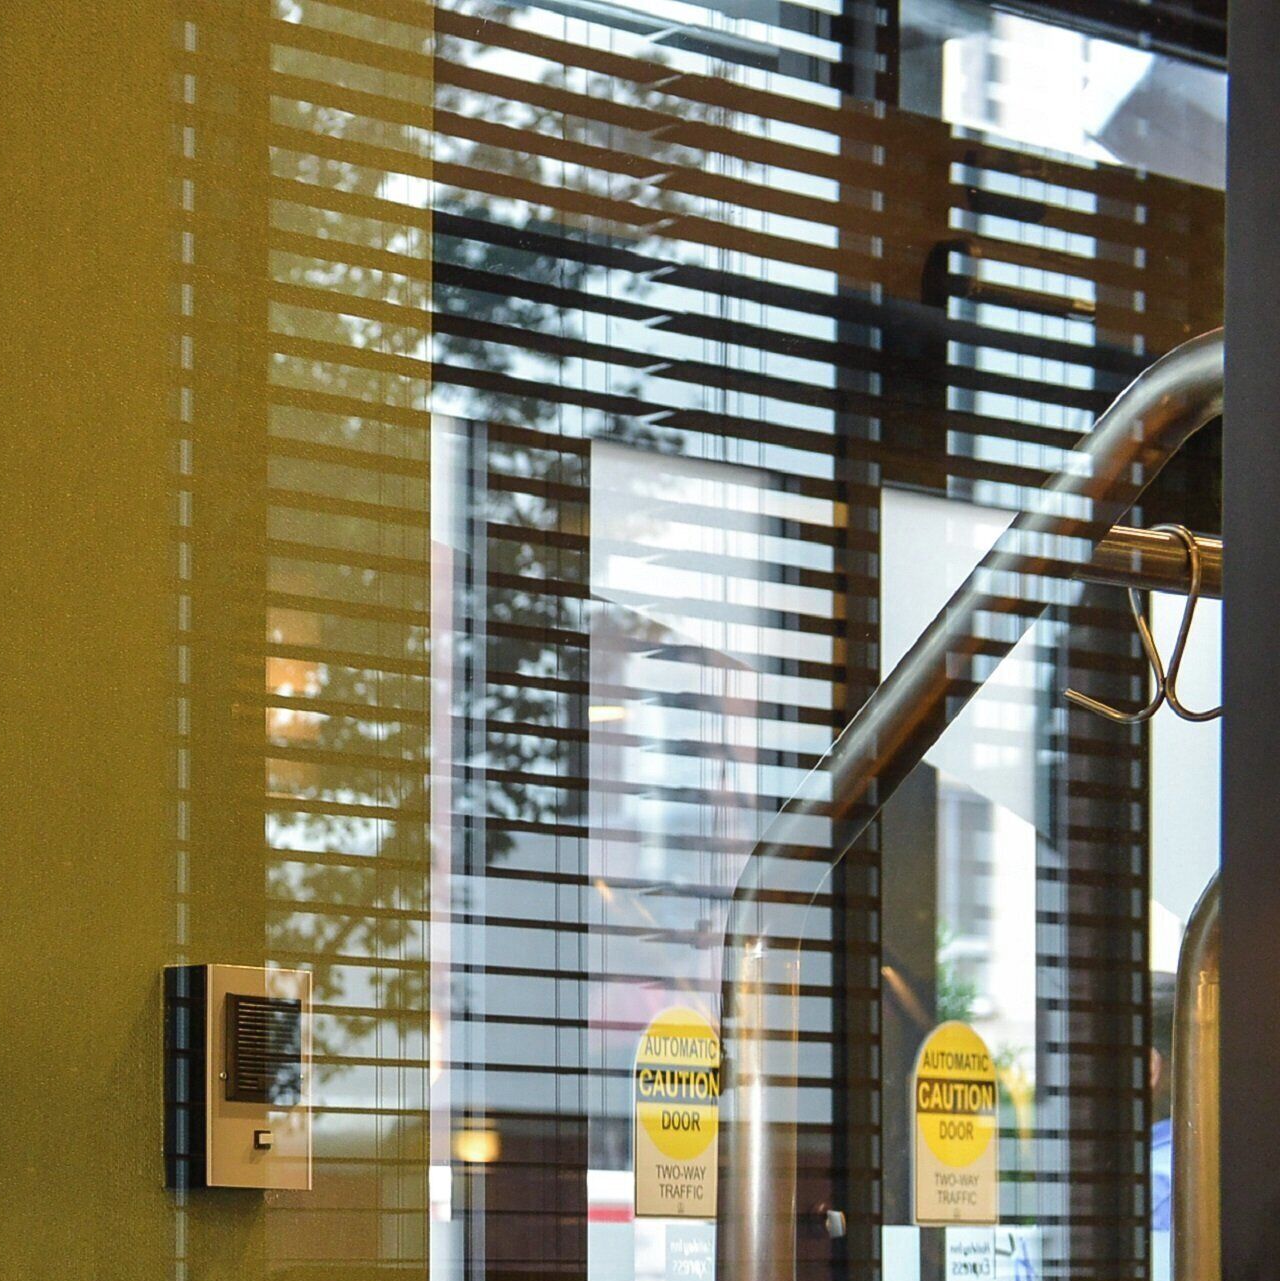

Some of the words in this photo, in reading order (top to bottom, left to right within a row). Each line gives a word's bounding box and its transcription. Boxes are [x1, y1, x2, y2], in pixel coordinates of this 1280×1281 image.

[645, 1036, 718, 1060] AUTOMATIC
[923, 1052, 989, 1071] AUTOMATIC
[639, 1069, 719, 1100] CAUTION
[918, 1081, 993, 1110] CAUTION
[662, 1111, 701, 1131] DOOR
[939, 1121, 974, 1140] DOOR
[656, 1164, 706, 1181] TWO-WAY
[934, 1172, 979, 1187] TWO-WAY
[659, 1184, 703, 1200] TRAFFIC
[937, 1190, 977, 1206] TRAFFIC
